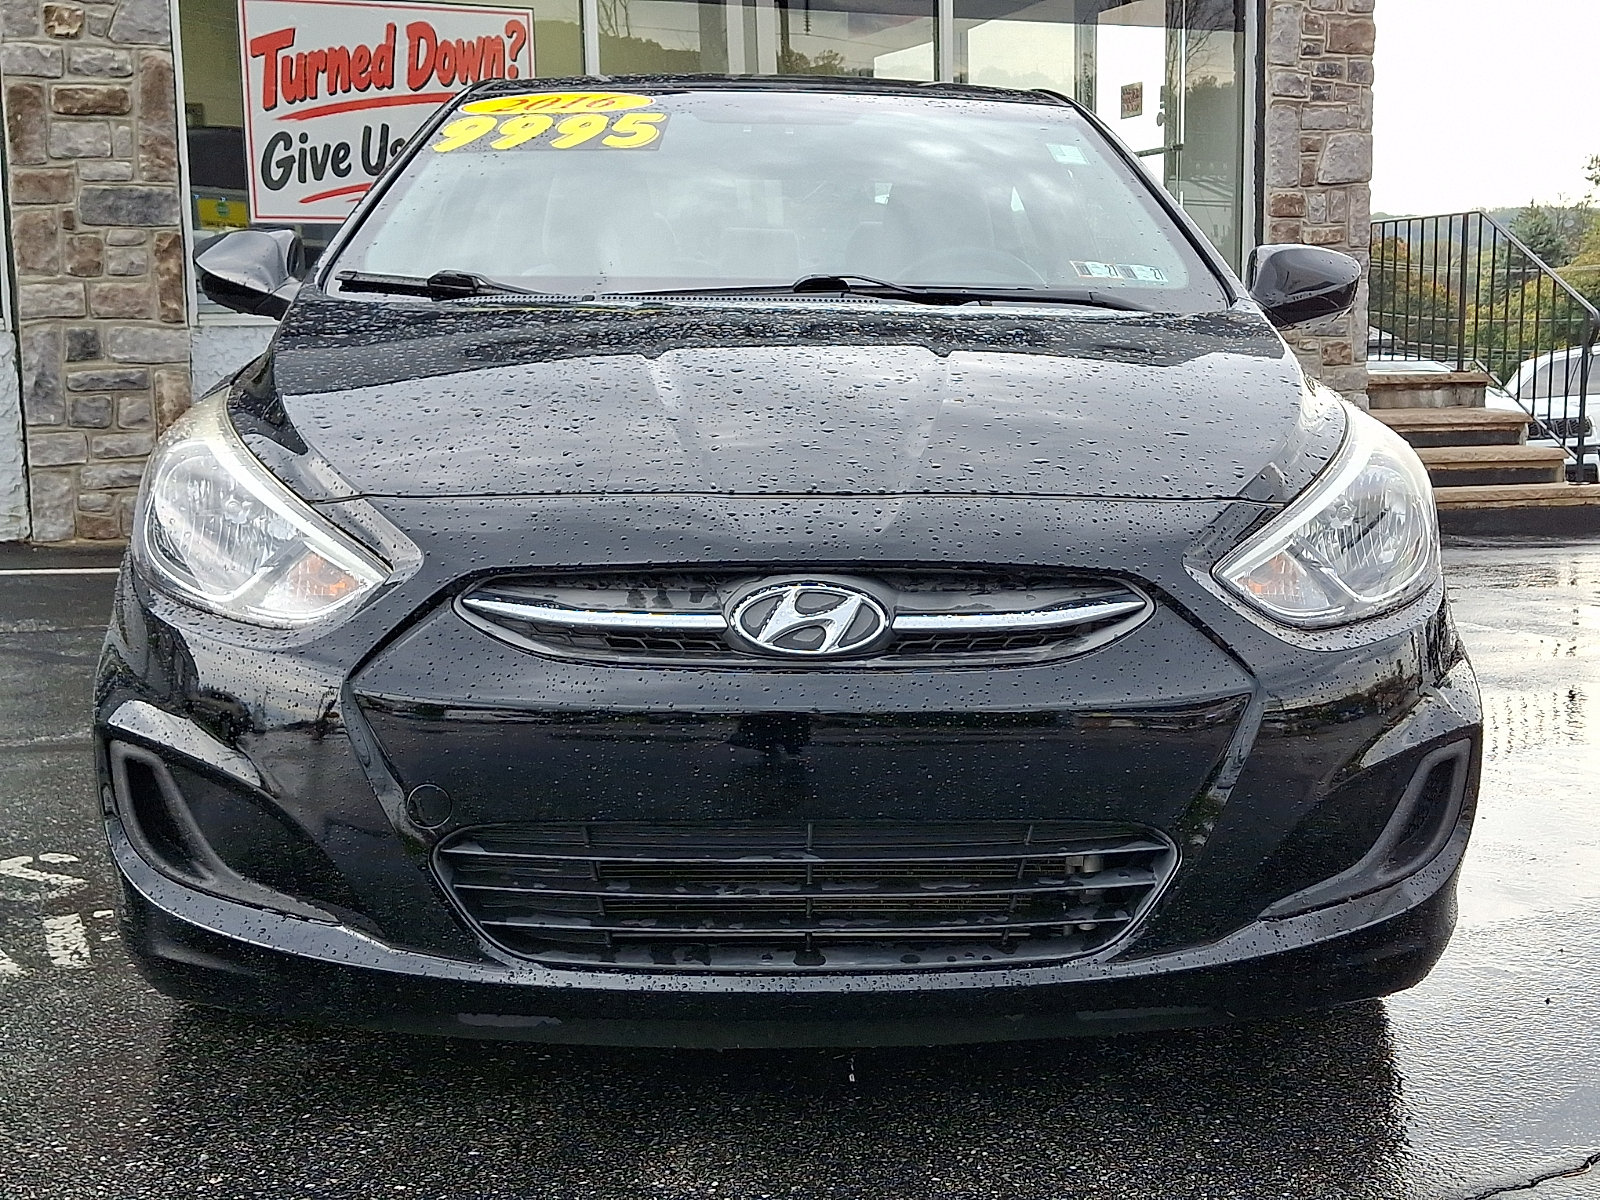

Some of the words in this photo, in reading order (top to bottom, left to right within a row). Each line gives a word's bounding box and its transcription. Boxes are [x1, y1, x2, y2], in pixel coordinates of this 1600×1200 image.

[250, 22, 396, 111] Turned
[406, 19, 527, 91] Down?
[490, 96, 616, 112] 2016
[432, 113, 668, 153] 9995
[261, 131, 352, 191] Give
